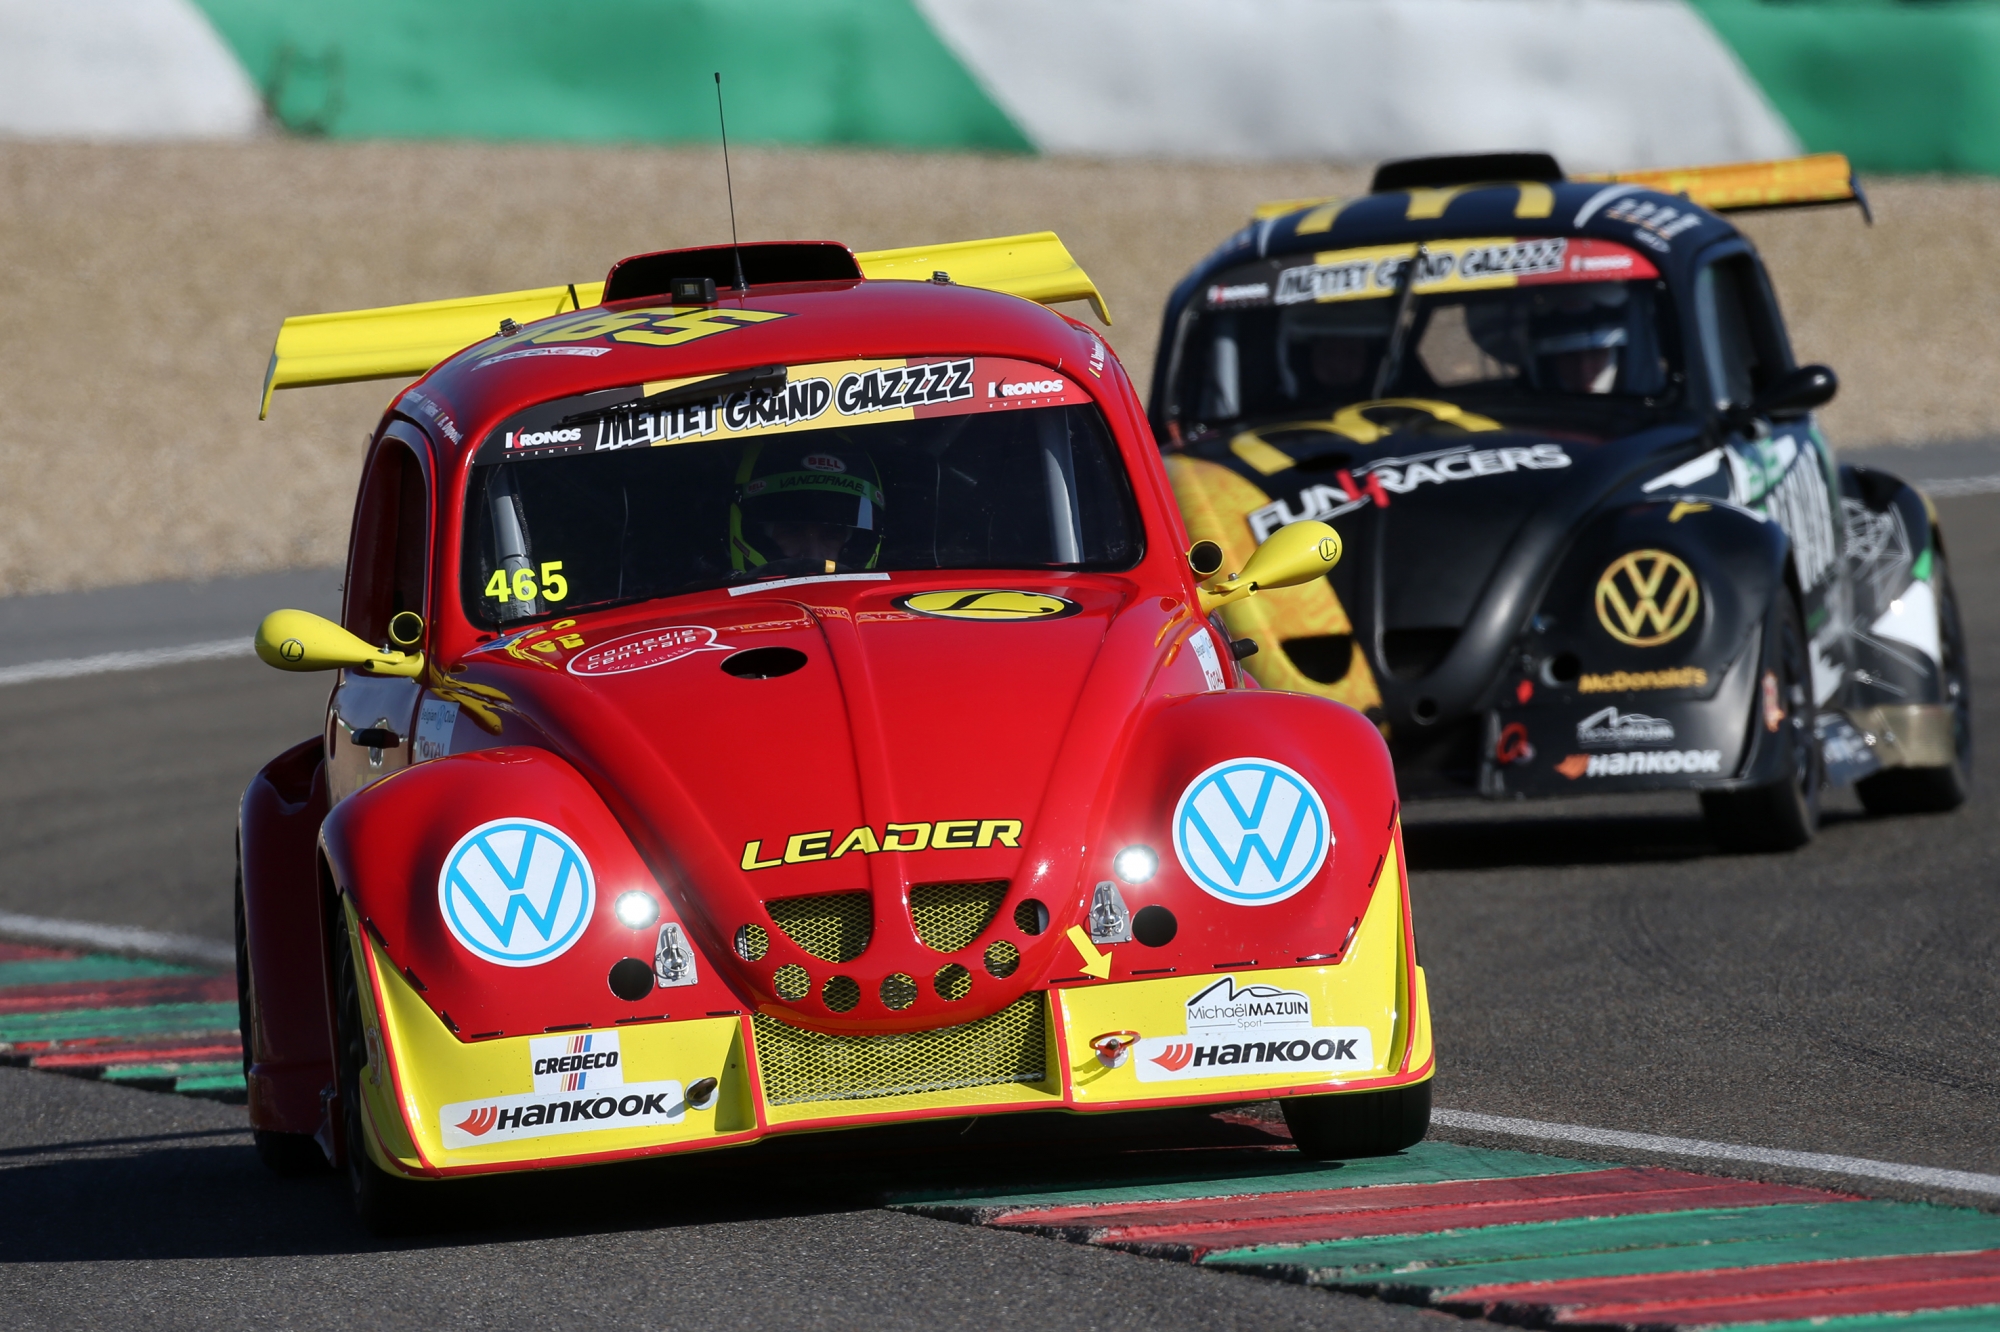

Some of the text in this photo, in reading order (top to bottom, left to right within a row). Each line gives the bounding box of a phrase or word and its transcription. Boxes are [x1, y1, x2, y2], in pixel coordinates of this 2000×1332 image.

[988, 377, 1063, 398] KRONOS
[595, 357, 974, 451] METTET GRAND GAZZZZ
[505, 427, 582, 449] KRONOS
[808, 456, 841, 469] BELL
[485, 561, 568, 602] 465
[740, 819, 1023, 871] LEADER
[1237, 1018, 1262, 1030] Sport
[534, 1051, 619, 1075] CREDECO
